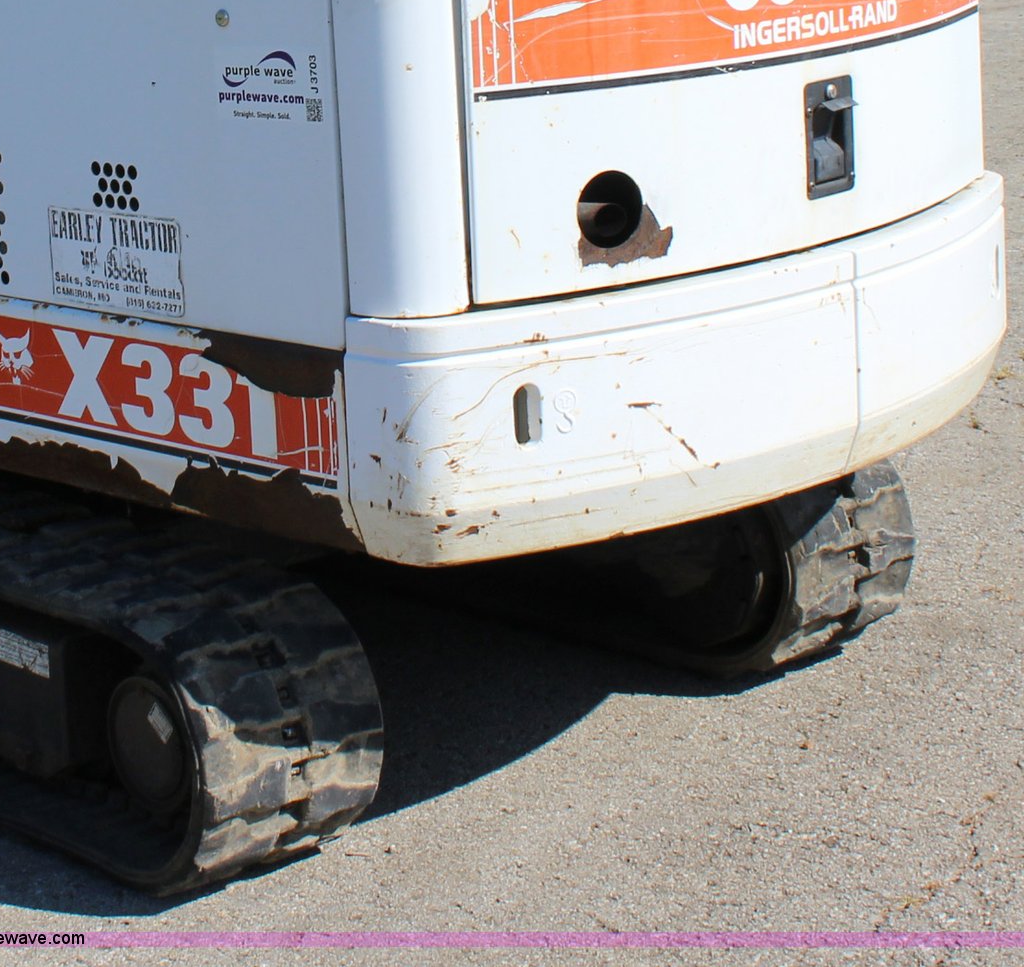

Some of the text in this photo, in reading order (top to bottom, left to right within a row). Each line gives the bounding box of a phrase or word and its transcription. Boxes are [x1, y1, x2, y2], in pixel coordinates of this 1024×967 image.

[225, 65, 293, 78] purple wave
[308, 54, 319, 85] 3703
[218, 90, 305, 104] purplewave.com
[233, 110, 292, 120] Straight. Simple. Sold.
[51, 209, 177, 254] EARLEY TRACTOR
[55, 271, 181, 301] Sales, Service and Rentals
[51, 328, 278, 460] X331
